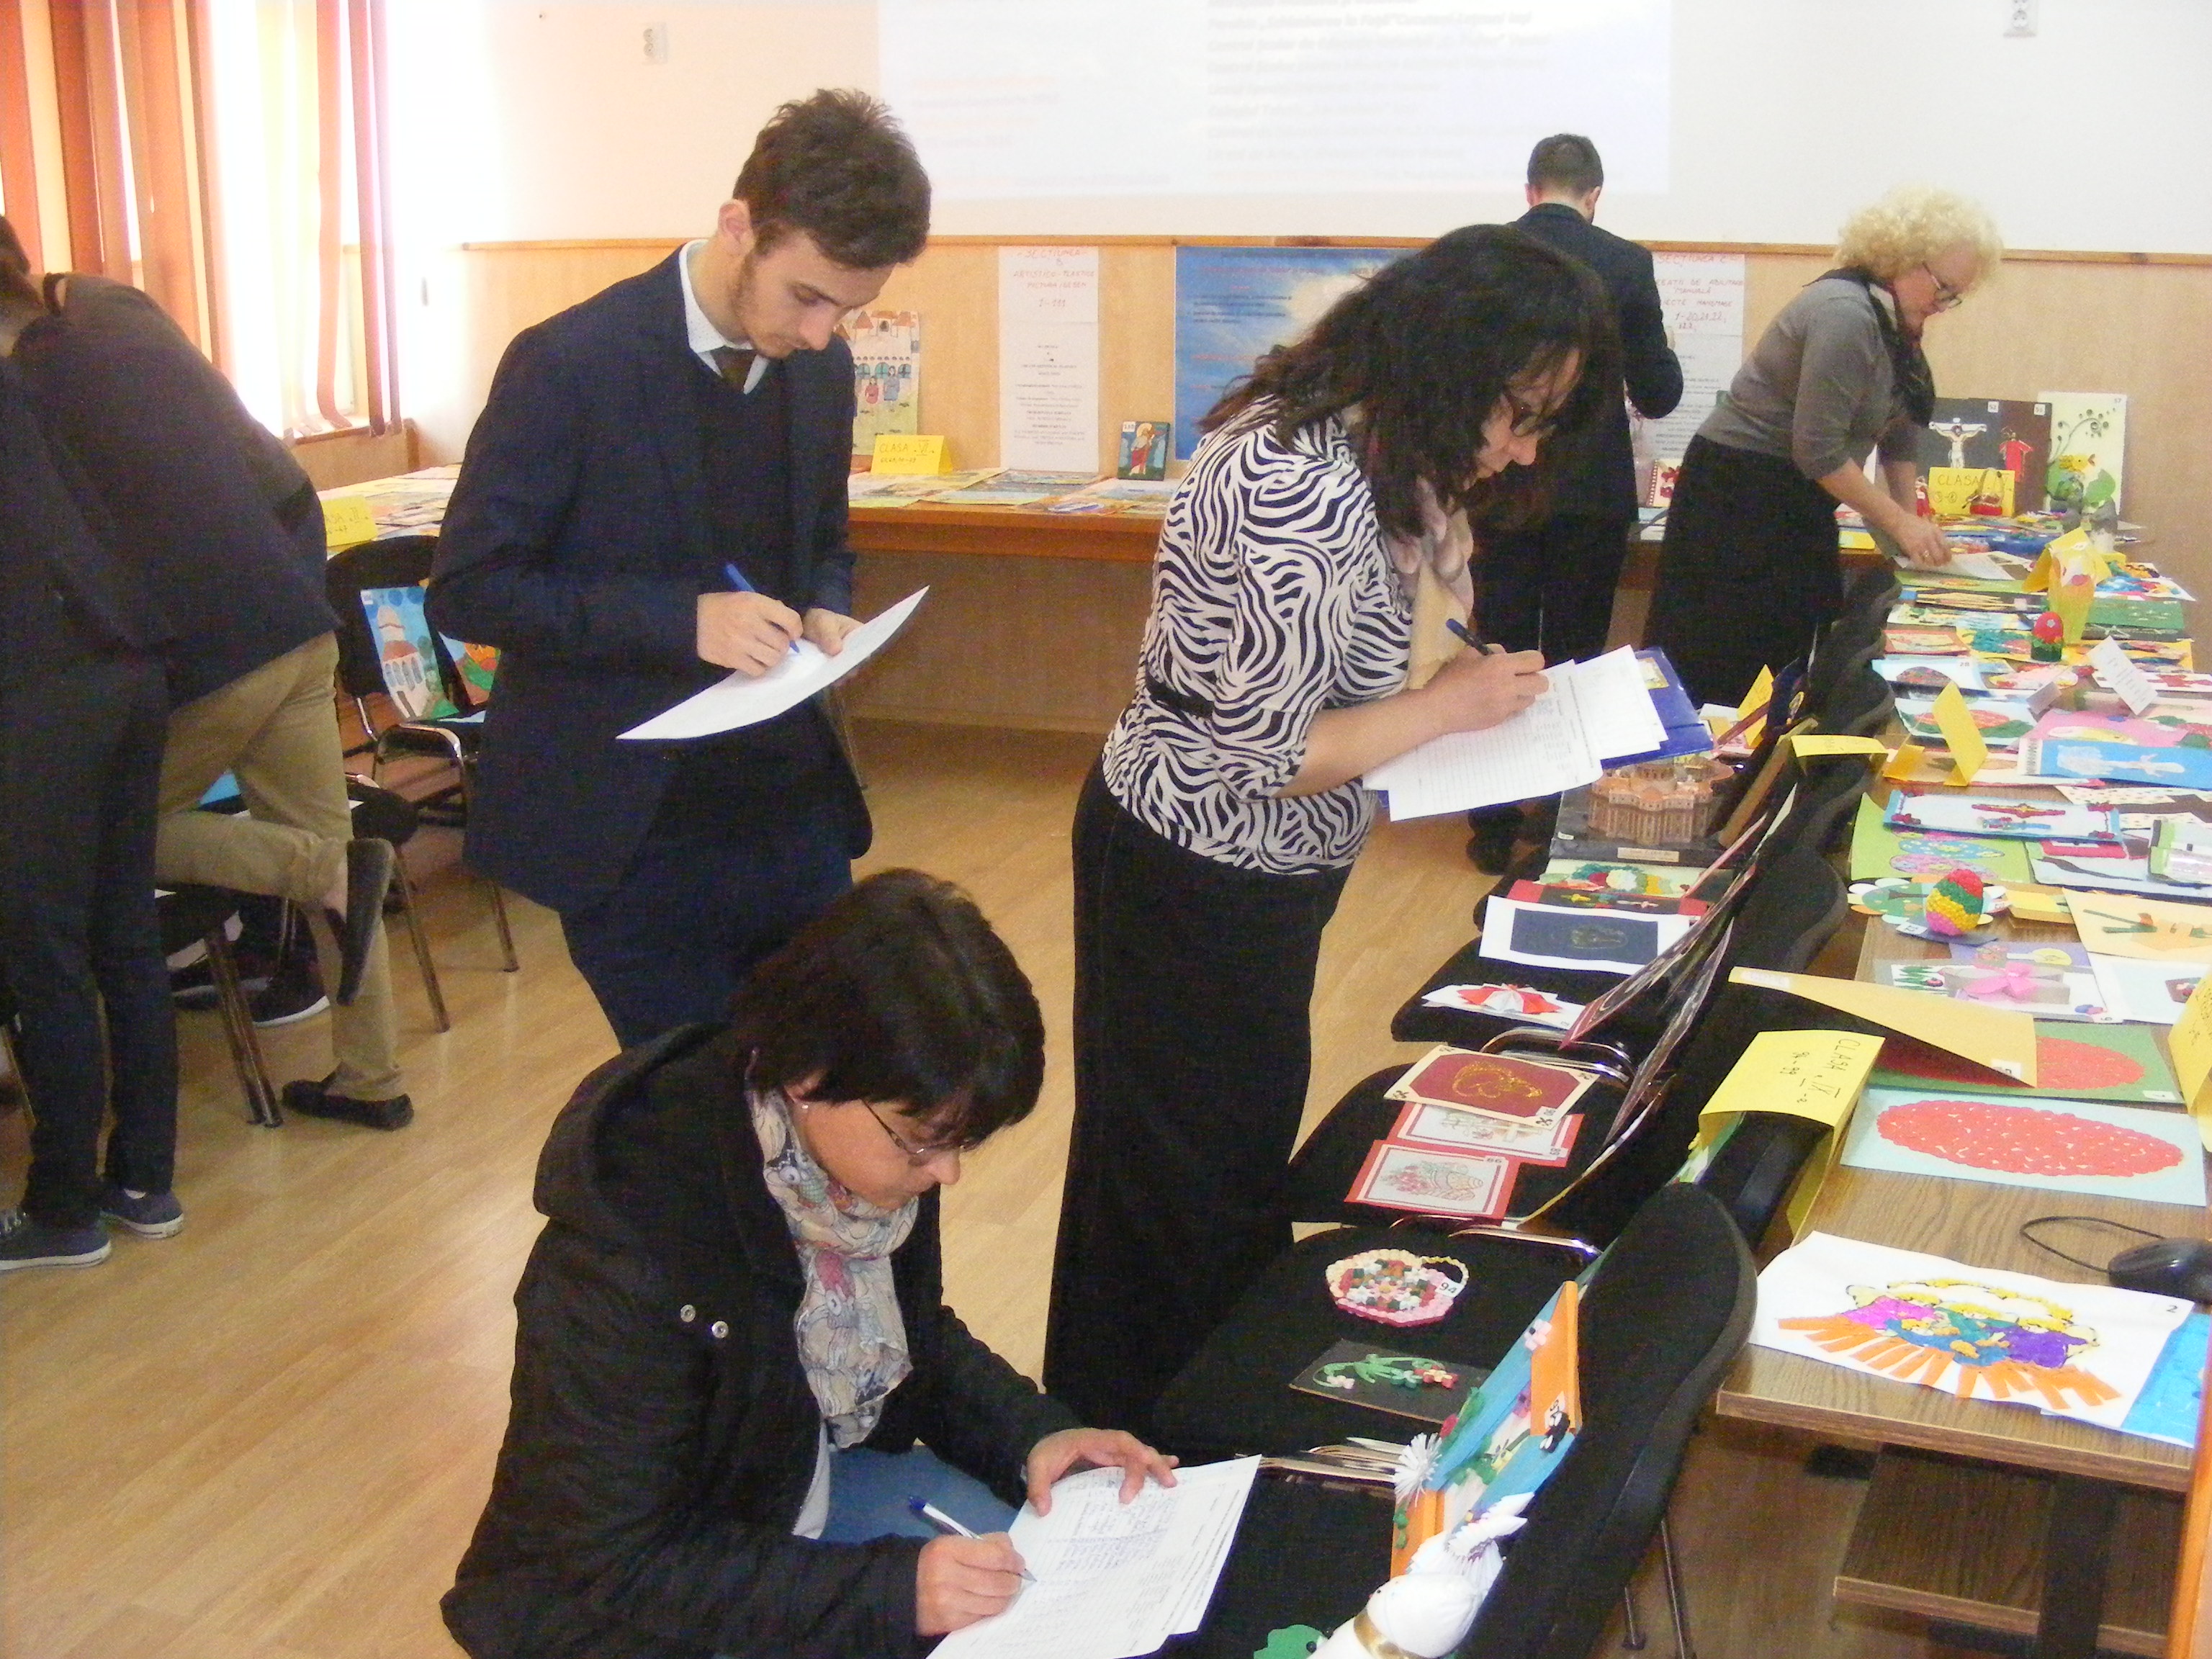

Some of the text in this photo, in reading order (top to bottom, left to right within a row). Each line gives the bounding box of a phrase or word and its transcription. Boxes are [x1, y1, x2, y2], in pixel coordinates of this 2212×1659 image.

[1821, 1038, 1861, 1071] CLASA
[1439, 1282, 1457, 1293] 94
[2166, 1305, 2178, 1313] 2
